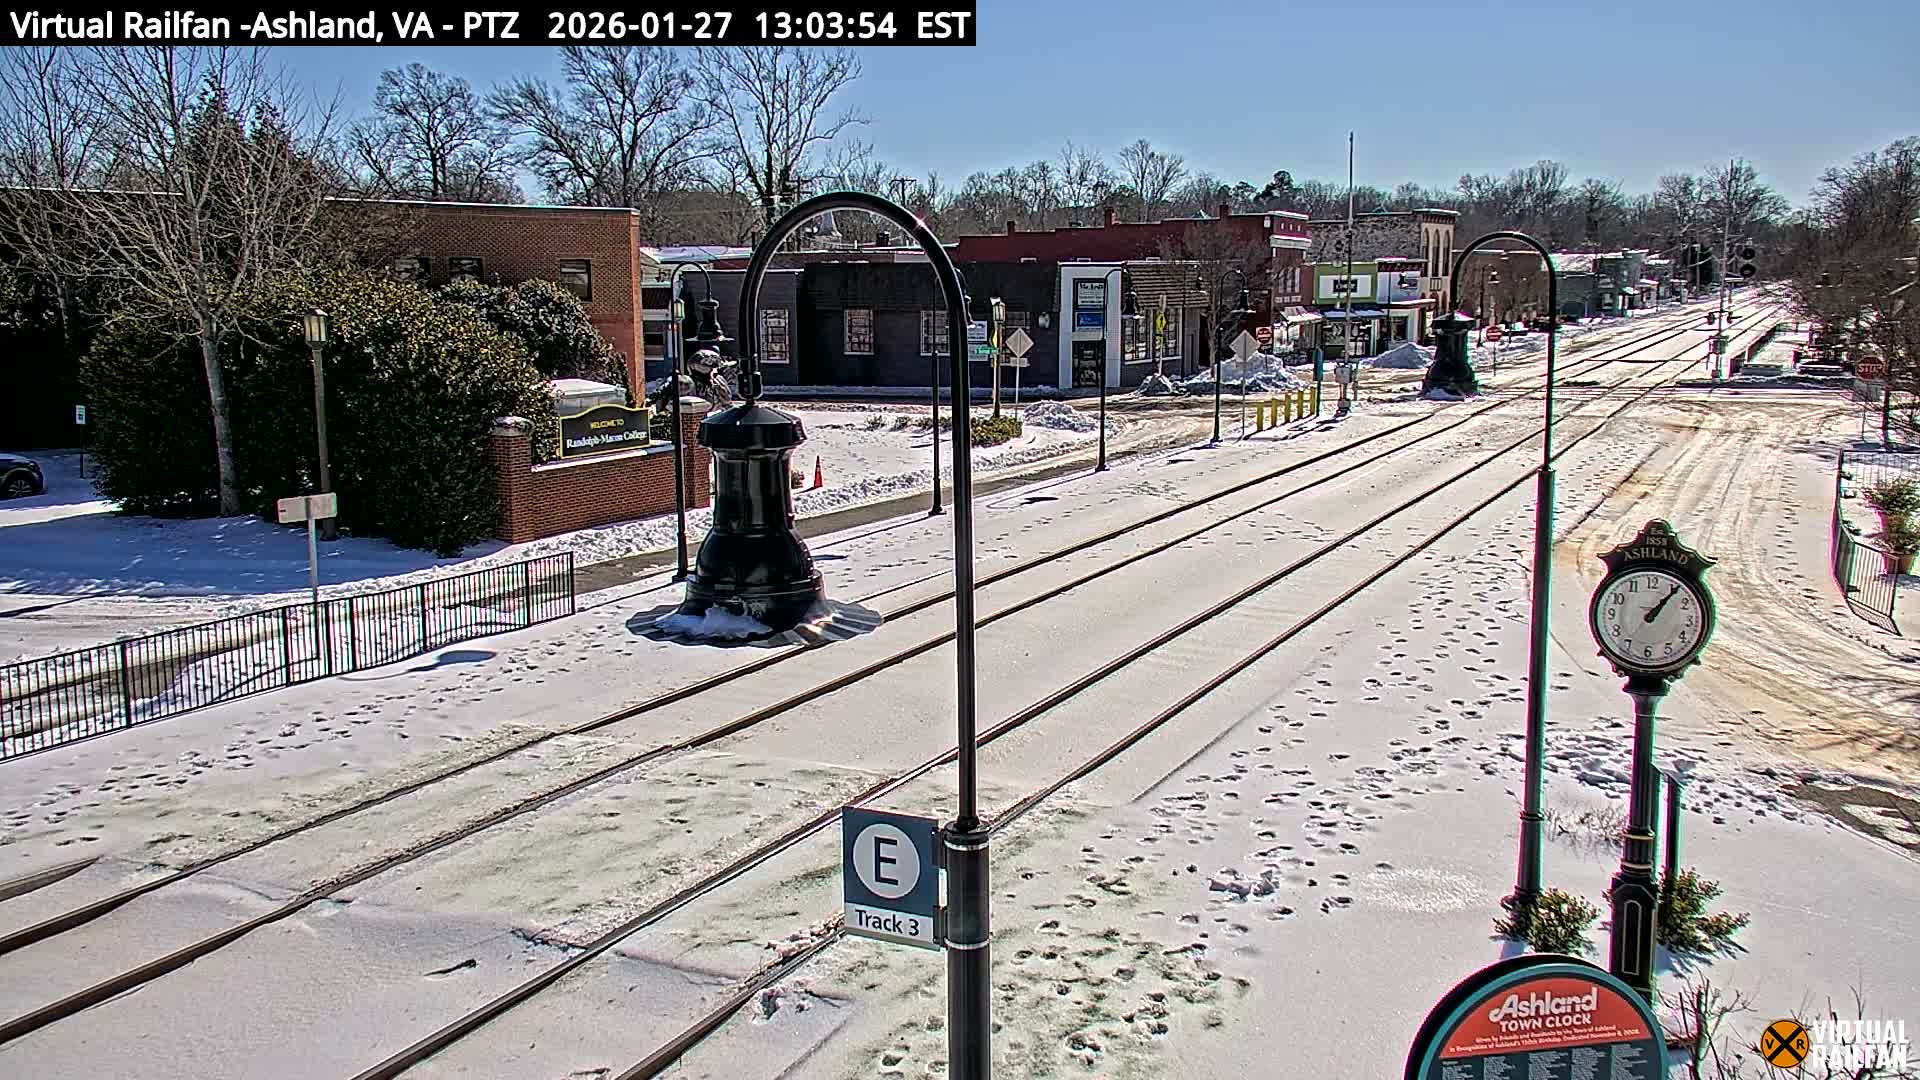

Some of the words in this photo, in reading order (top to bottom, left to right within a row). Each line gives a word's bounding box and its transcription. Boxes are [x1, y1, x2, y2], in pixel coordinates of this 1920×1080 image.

[566, 433, 623, 449] Randolph-Macon
[623, 430, 648, 441] College
[1624, 547, 1688, 565] ASHLAND
[1629, 581, 1638, 592] 11
[1647, 576, 1659, 590] 12
[1608, 592, 1624, 605] 10
[1680, 597, 1689, 610] 2
[1607, 608, 1616, 620] 9
[1686, 615, 1694, 627] 3
[1612, 624, 1621, 637] 8
[1678, 630, 1687, 643] 4
[1624, 639, 1632, 651] 7
[1644, 645, 1653, 657] 6
[1664, 642, 1673, 655] 5
[874, 836, 899, 886] E
[855, 909, 903, 934] Track
[908, 918, 920, 936] 3
[1488, 985, 1600, 1023] Ashland
[1499, 1018, 1542, 1033] TOWN
[1545, 1012, 1592, 1028] CLOCK
